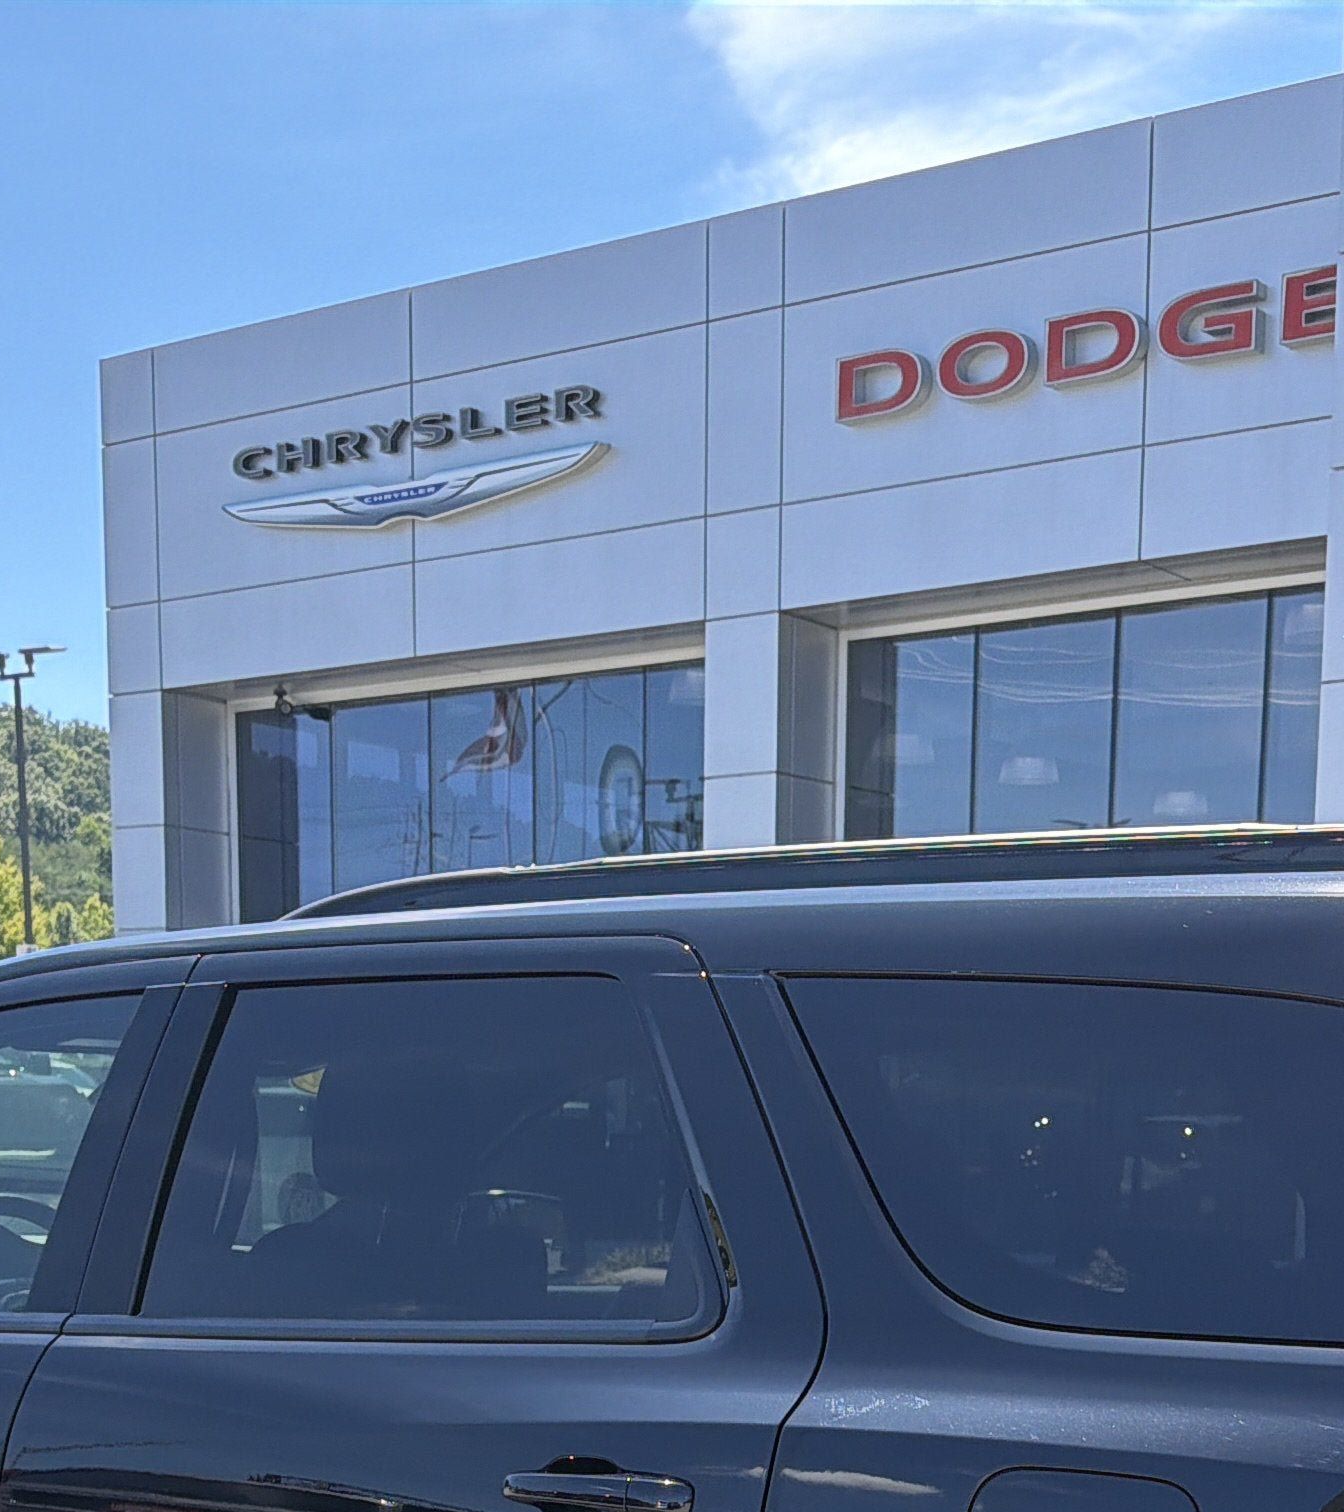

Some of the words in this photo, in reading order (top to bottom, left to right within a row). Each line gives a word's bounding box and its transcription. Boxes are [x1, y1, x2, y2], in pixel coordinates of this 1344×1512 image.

[835, 264, 1337, 423] DODGE
[232, 384, 601, 480] CHRYSLER
[363, 486, 436, 503] CHRYSLER
